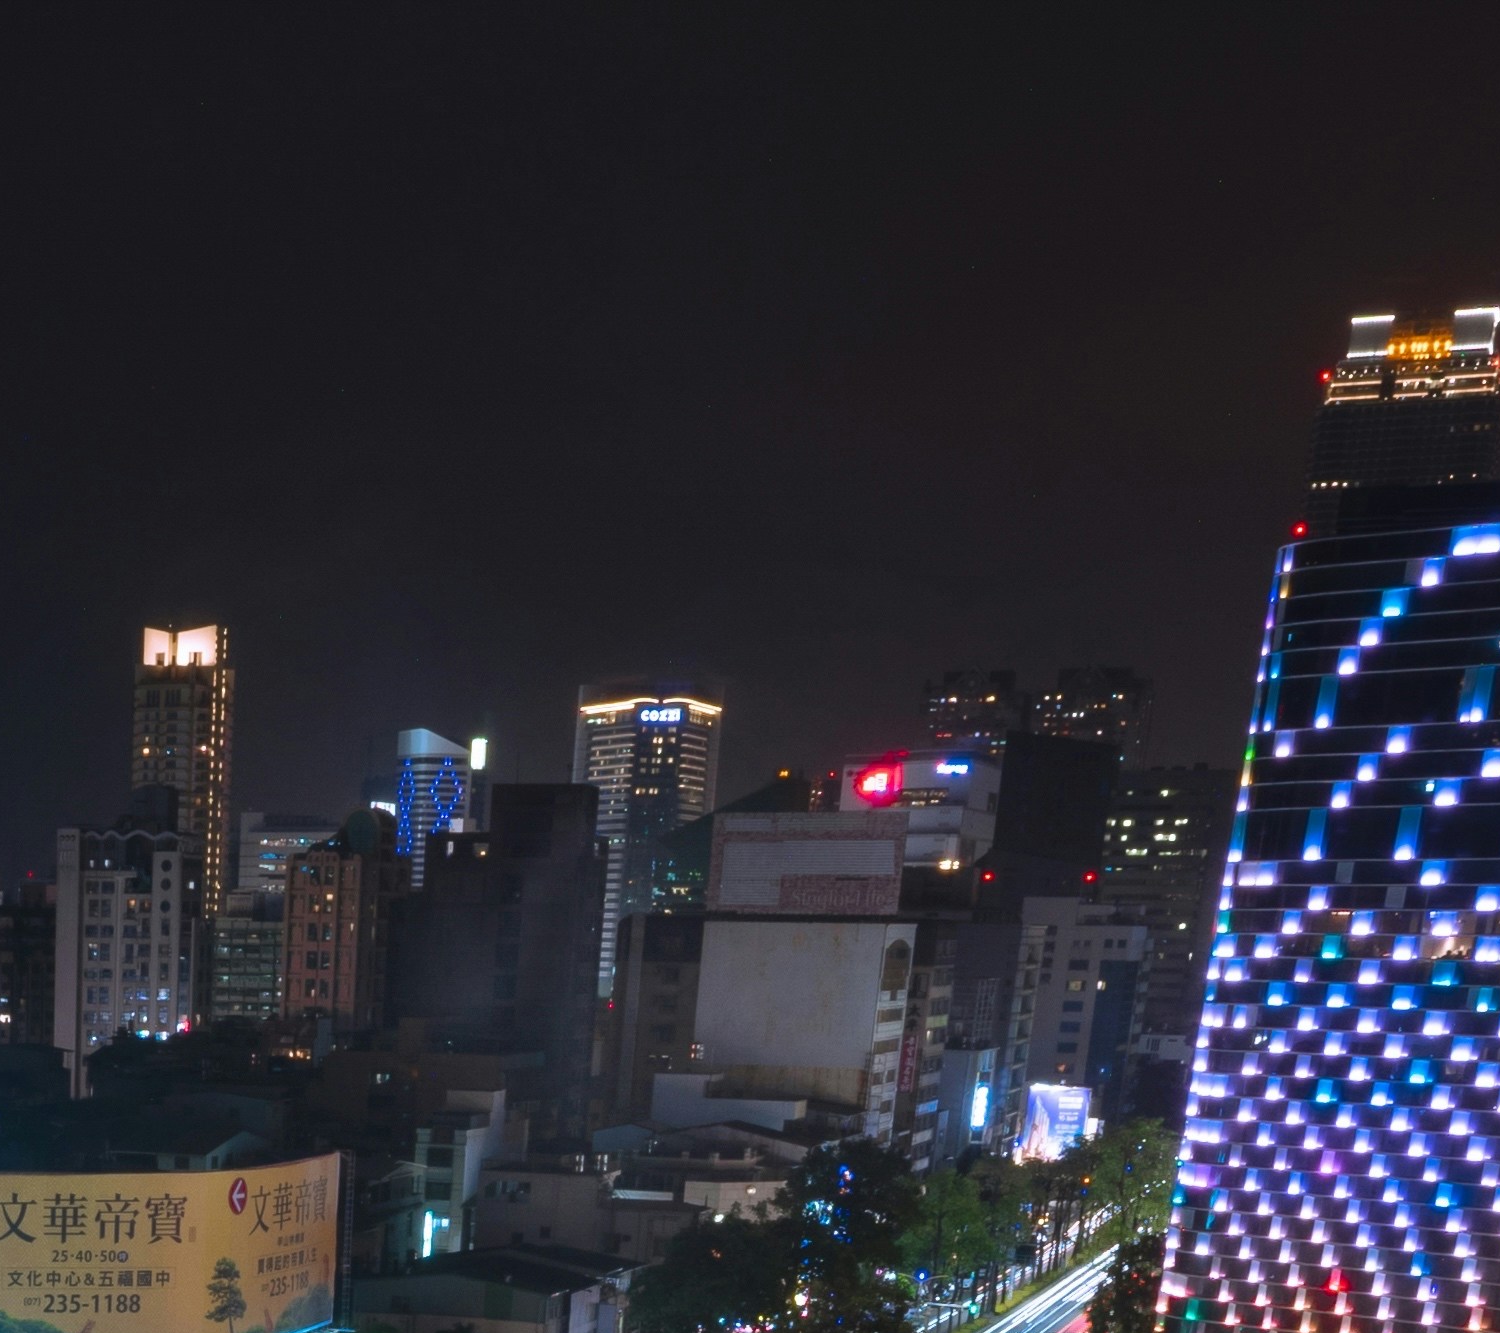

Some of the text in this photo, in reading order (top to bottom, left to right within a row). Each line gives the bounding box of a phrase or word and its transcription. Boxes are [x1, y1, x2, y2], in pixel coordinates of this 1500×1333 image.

[249, 1177, 329, 1236] 文華帝寶
[7, 1269, 172, 1289] 文化中心&五福國中
[43, 1293, 141, 1314] 235-1188
